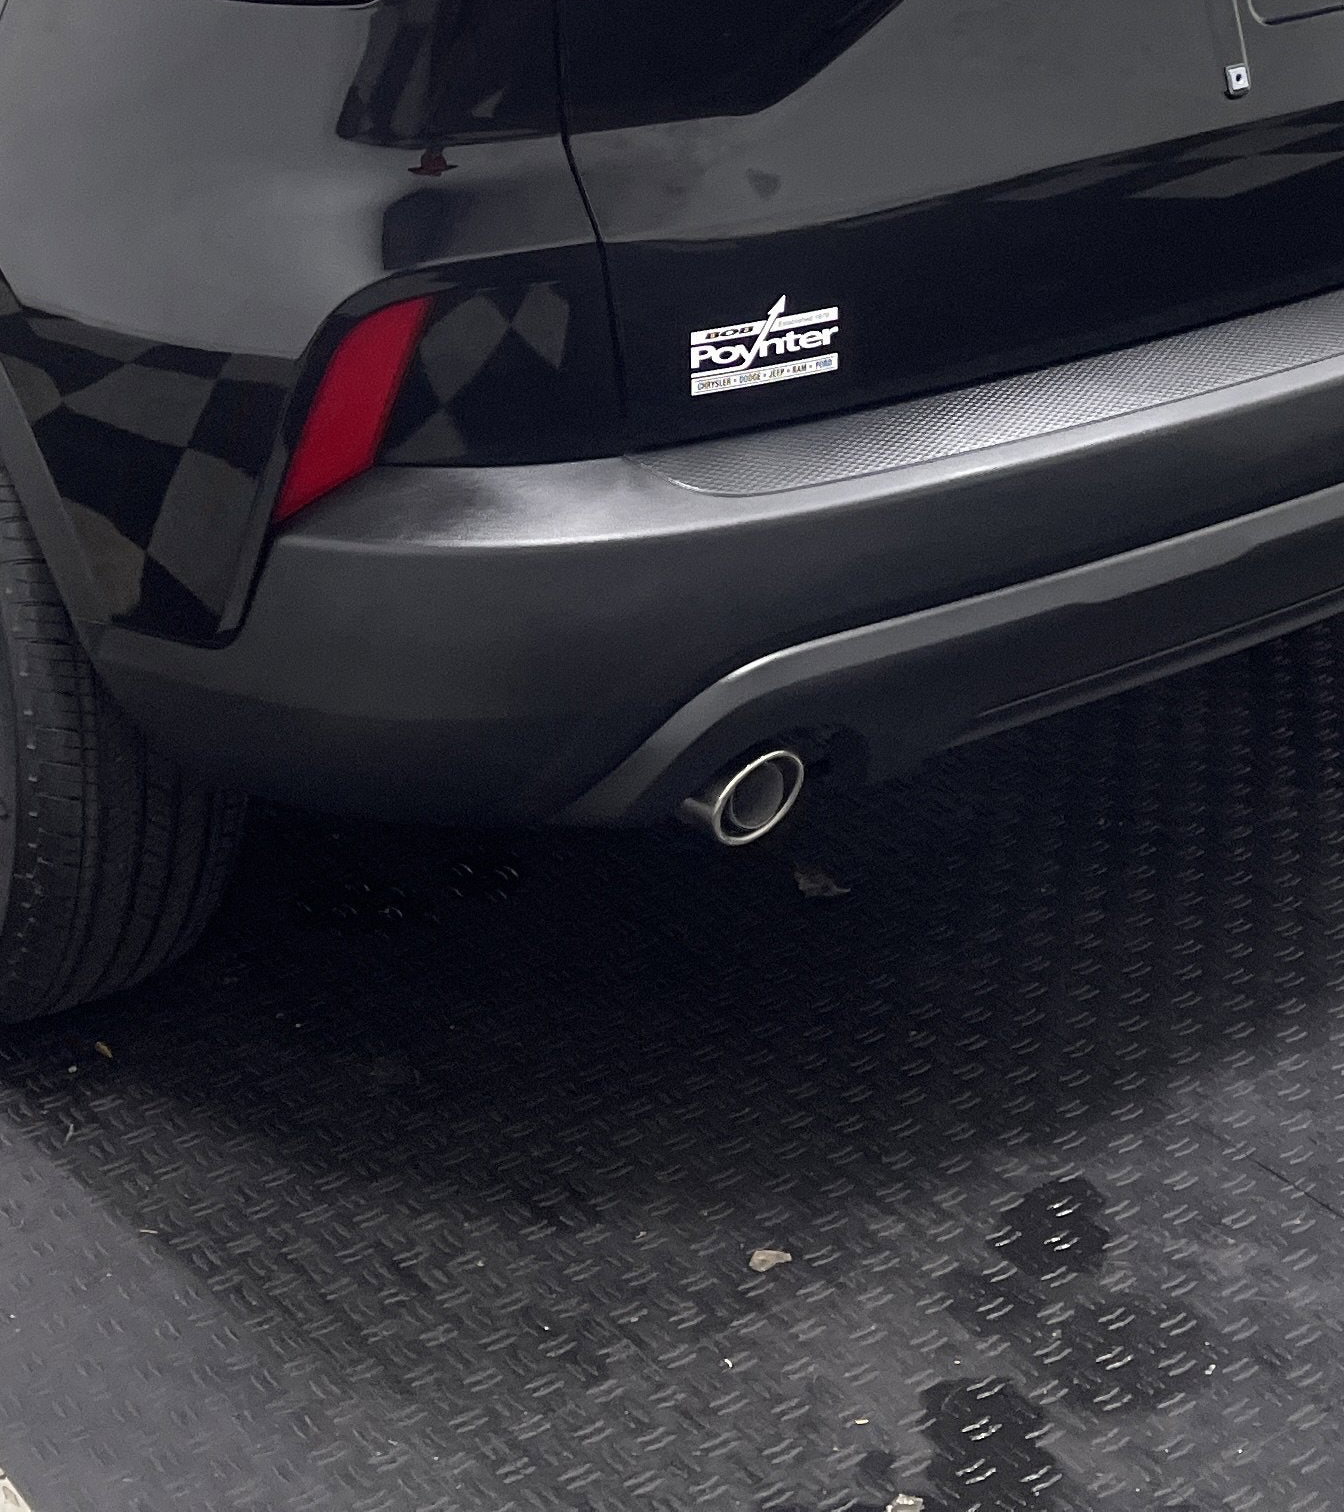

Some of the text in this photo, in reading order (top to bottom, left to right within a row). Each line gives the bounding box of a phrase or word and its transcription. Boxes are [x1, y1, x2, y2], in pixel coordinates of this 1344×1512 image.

[691, 325, 839, 370] Poynter
[705, 326, 754, 339] BOB
[697, 358, 833, 390] CHRYSLER DODGE JEEP RAM FORD
